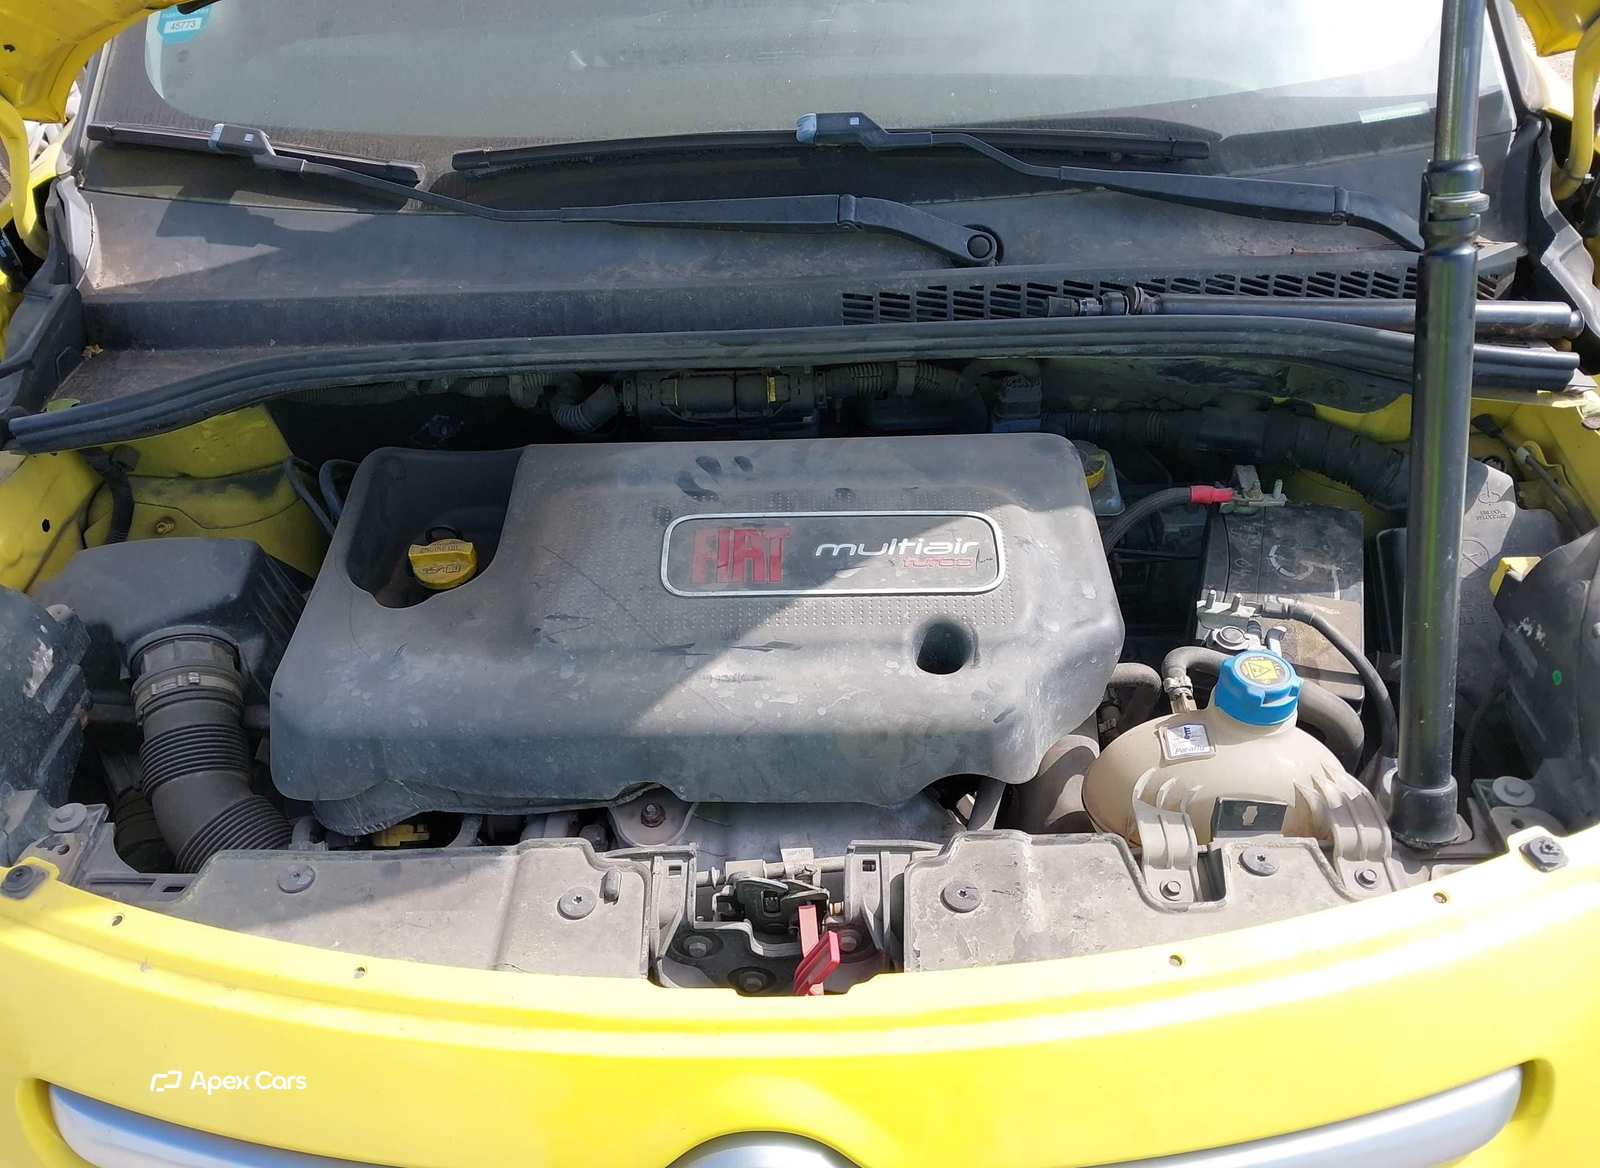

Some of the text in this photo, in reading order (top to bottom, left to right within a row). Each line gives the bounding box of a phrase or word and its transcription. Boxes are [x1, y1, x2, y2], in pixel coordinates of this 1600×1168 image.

[170, 20, 196, 30] 45773
[814, 537, 980, 557] multiair
[691, 528, 791, 584] FIAT
[903, 556, 976, 568] turbo
